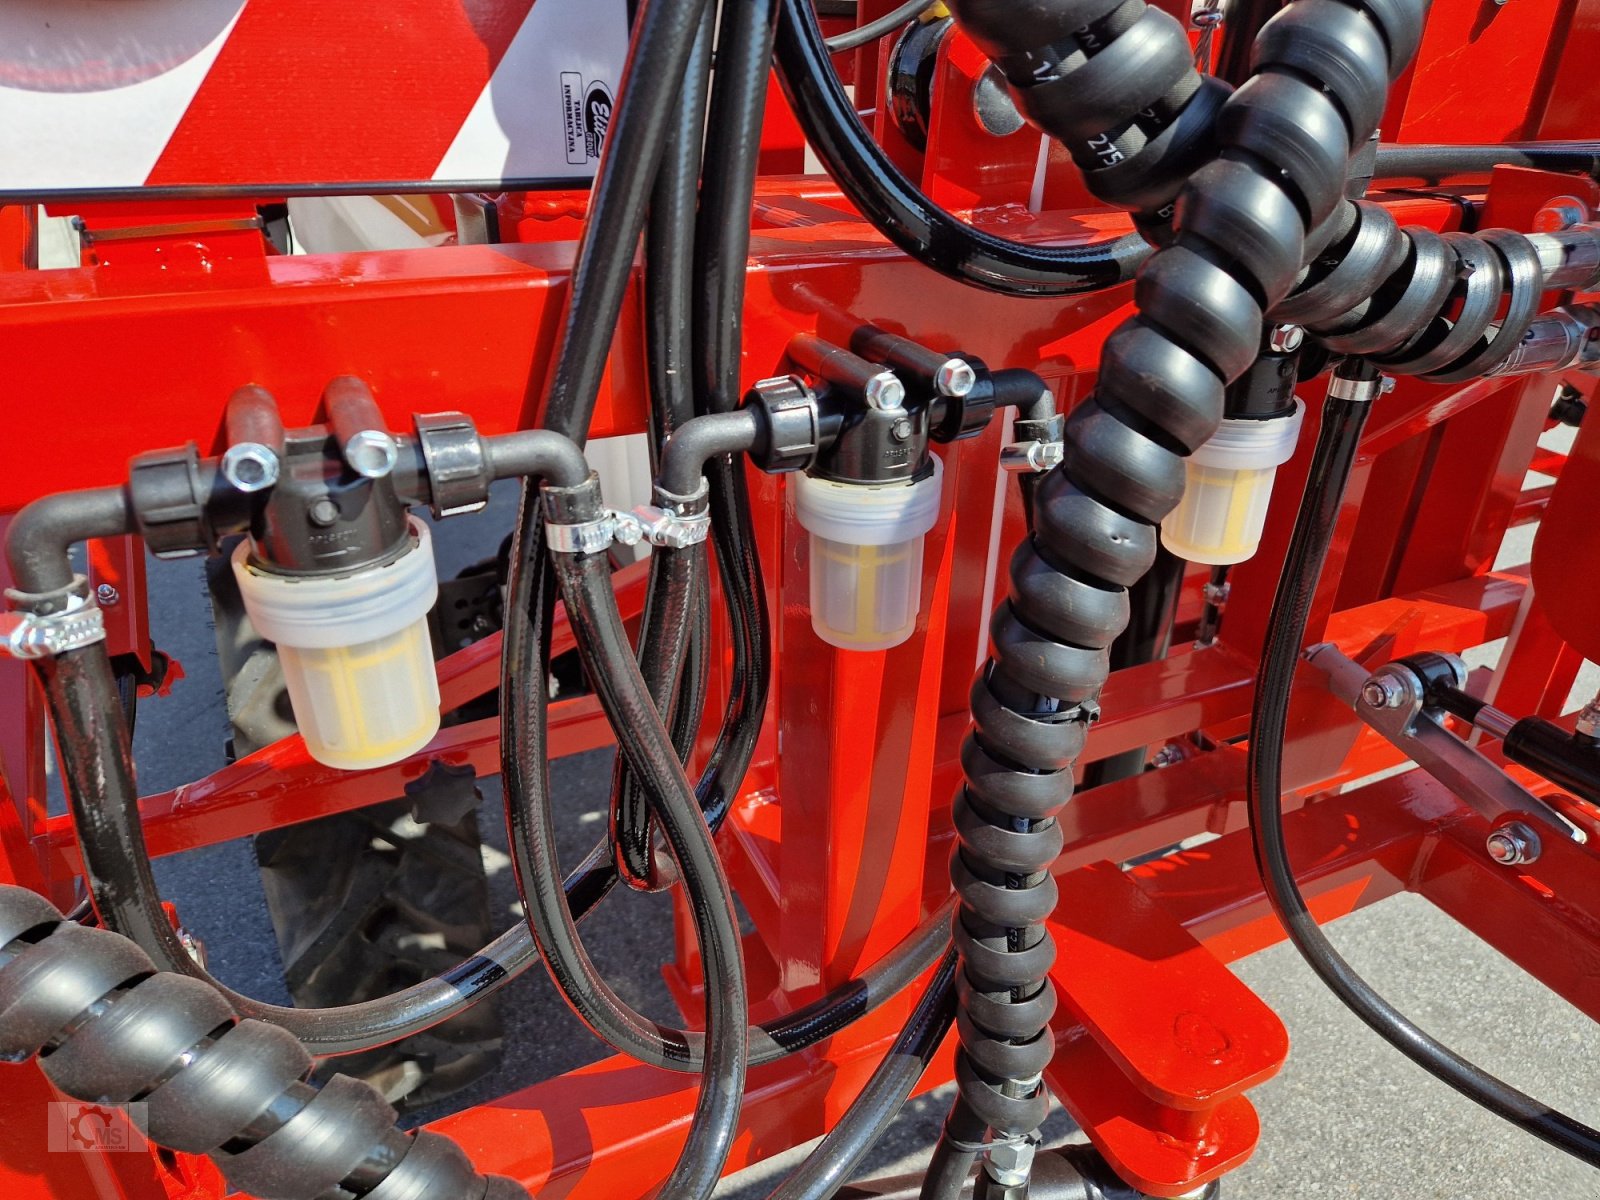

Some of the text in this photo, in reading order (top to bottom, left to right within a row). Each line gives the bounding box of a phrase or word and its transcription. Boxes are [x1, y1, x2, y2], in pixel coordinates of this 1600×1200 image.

[564, 84, 576, 153] INFORMACYJNA
[573, 100, 583, 138] TABLICA
[1087, 133, 1125, 166] 275
